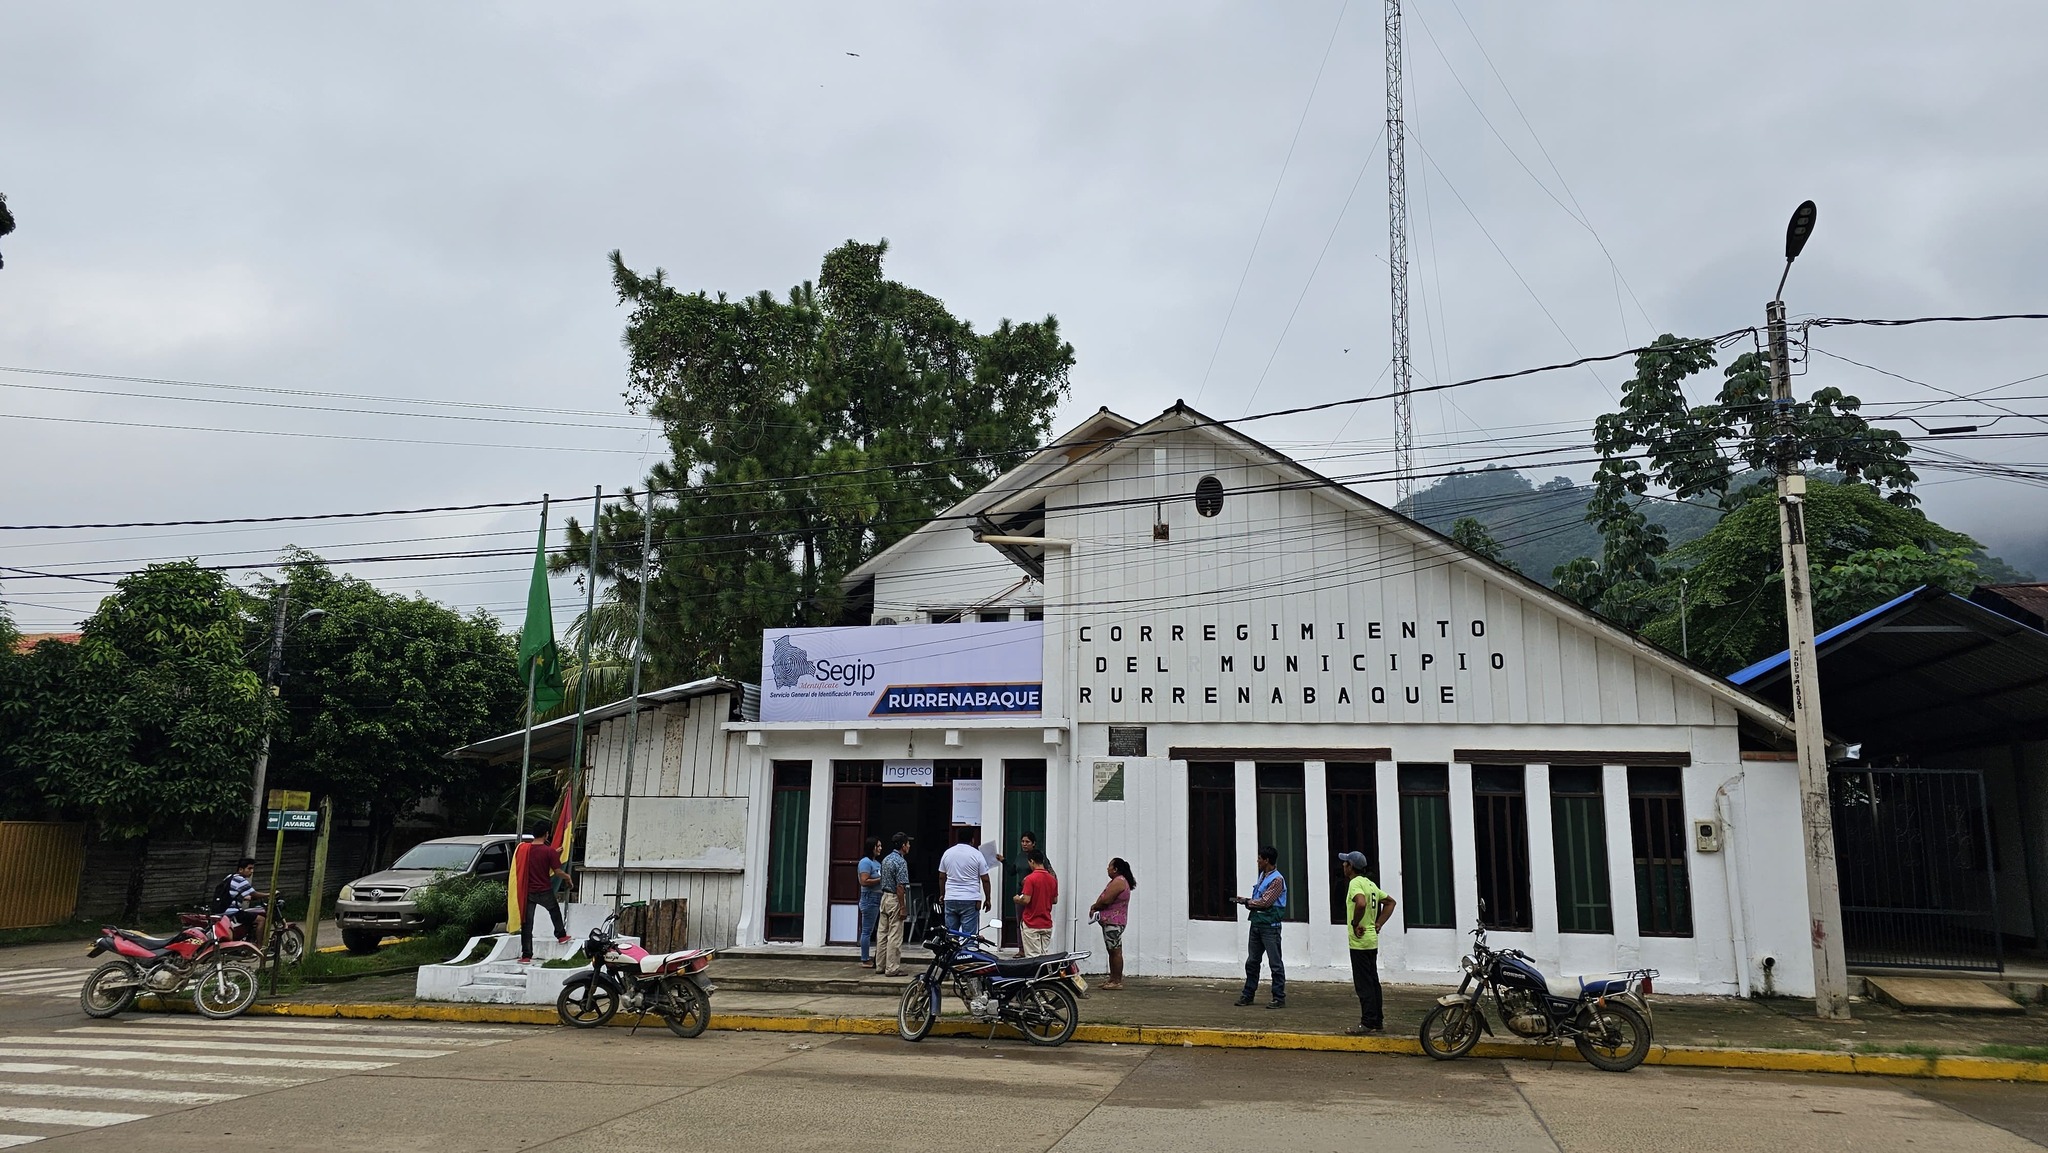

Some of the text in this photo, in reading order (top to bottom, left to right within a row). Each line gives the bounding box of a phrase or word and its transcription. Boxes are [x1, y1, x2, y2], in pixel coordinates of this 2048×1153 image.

[1079, 620, 1485, 643] CORREGIMIENTO
[1095, 652, 1504, 673] DEL MUNICIPIO
[815, 658, 875, 687] Segip
[818, 690, 852, 698] Identificación
[888, 691, 1040, 708] RURRENABAQUE
[1079, 685, 1455, 705] RURRENABAQUE
[885, 765, 933, 779] Ingreso
[1371, 892, 1377, 909] 6
[1502, 971, 1526, 980] CONDOR
